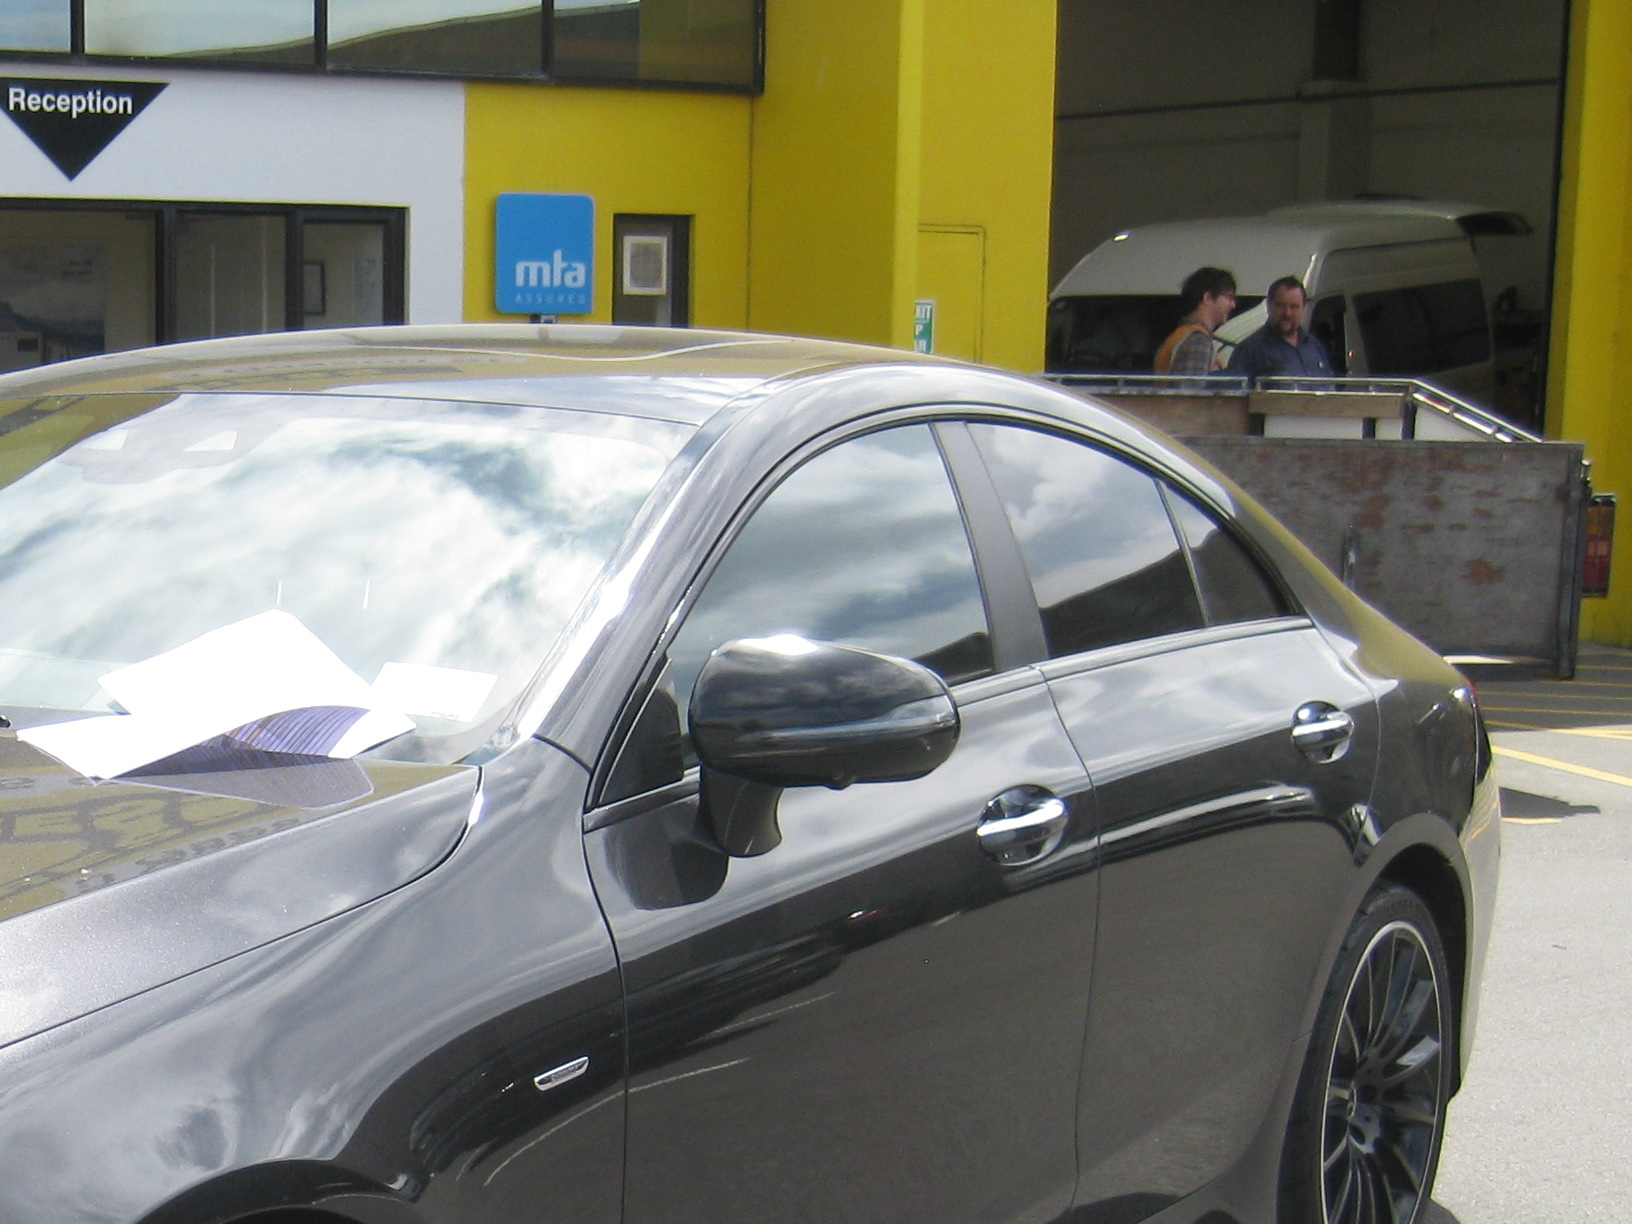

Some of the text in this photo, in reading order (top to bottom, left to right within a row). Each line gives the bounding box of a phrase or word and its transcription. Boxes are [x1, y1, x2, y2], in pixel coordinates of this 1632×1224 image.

[8, 86, 133, 119] Reception
[515, 248, 587, 289] mta
[515, 293, 586, 305] ASSURED
